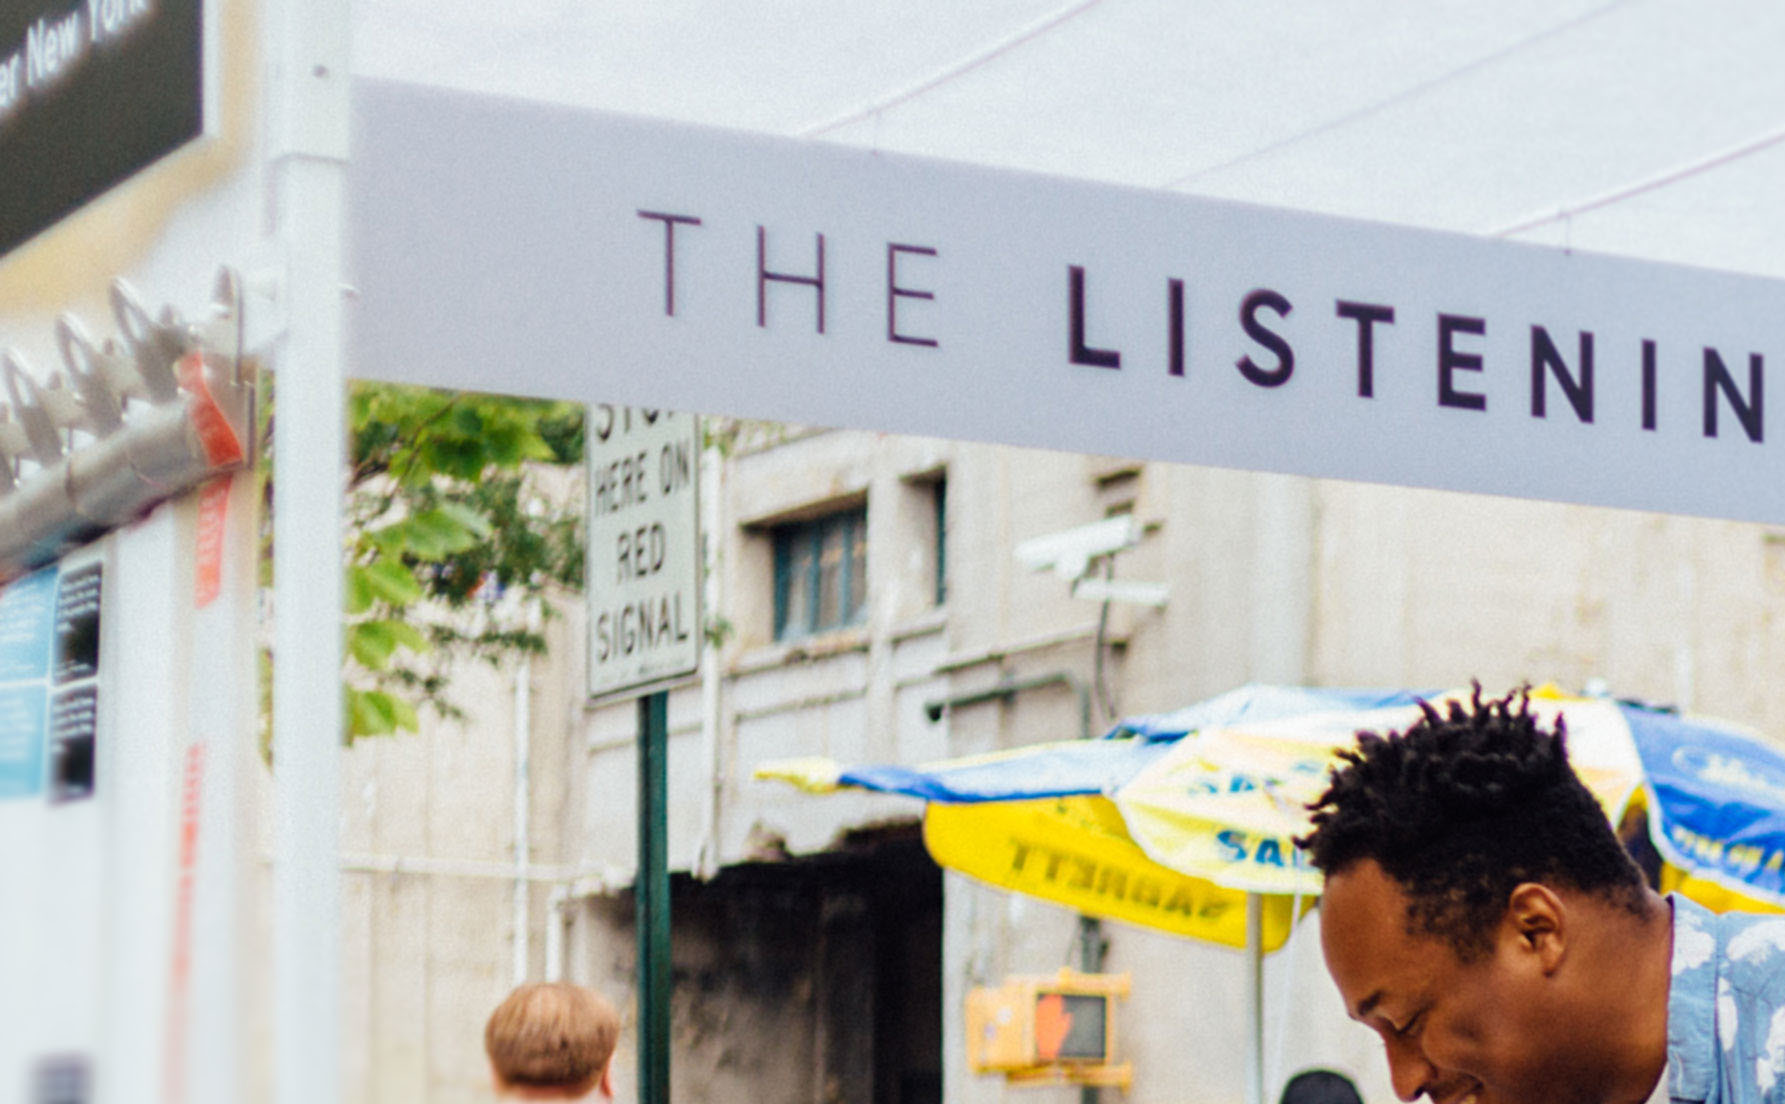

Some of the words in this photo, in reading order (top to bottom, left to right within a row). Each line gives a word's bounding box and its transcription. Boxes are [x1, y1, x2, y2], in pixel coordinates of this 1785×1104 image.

[27, 13, 79, 87] New
[86, 0, 150, 42] Yor
[636, 209, 940, 348] THE
[595, 402, 674, 441] ST
[595, 450, 647, 518] HERE
[659, 440, 690, 496] ON
[617, 521, 667, 585] RED
[595, 591, 689, 663] SIGNAL
